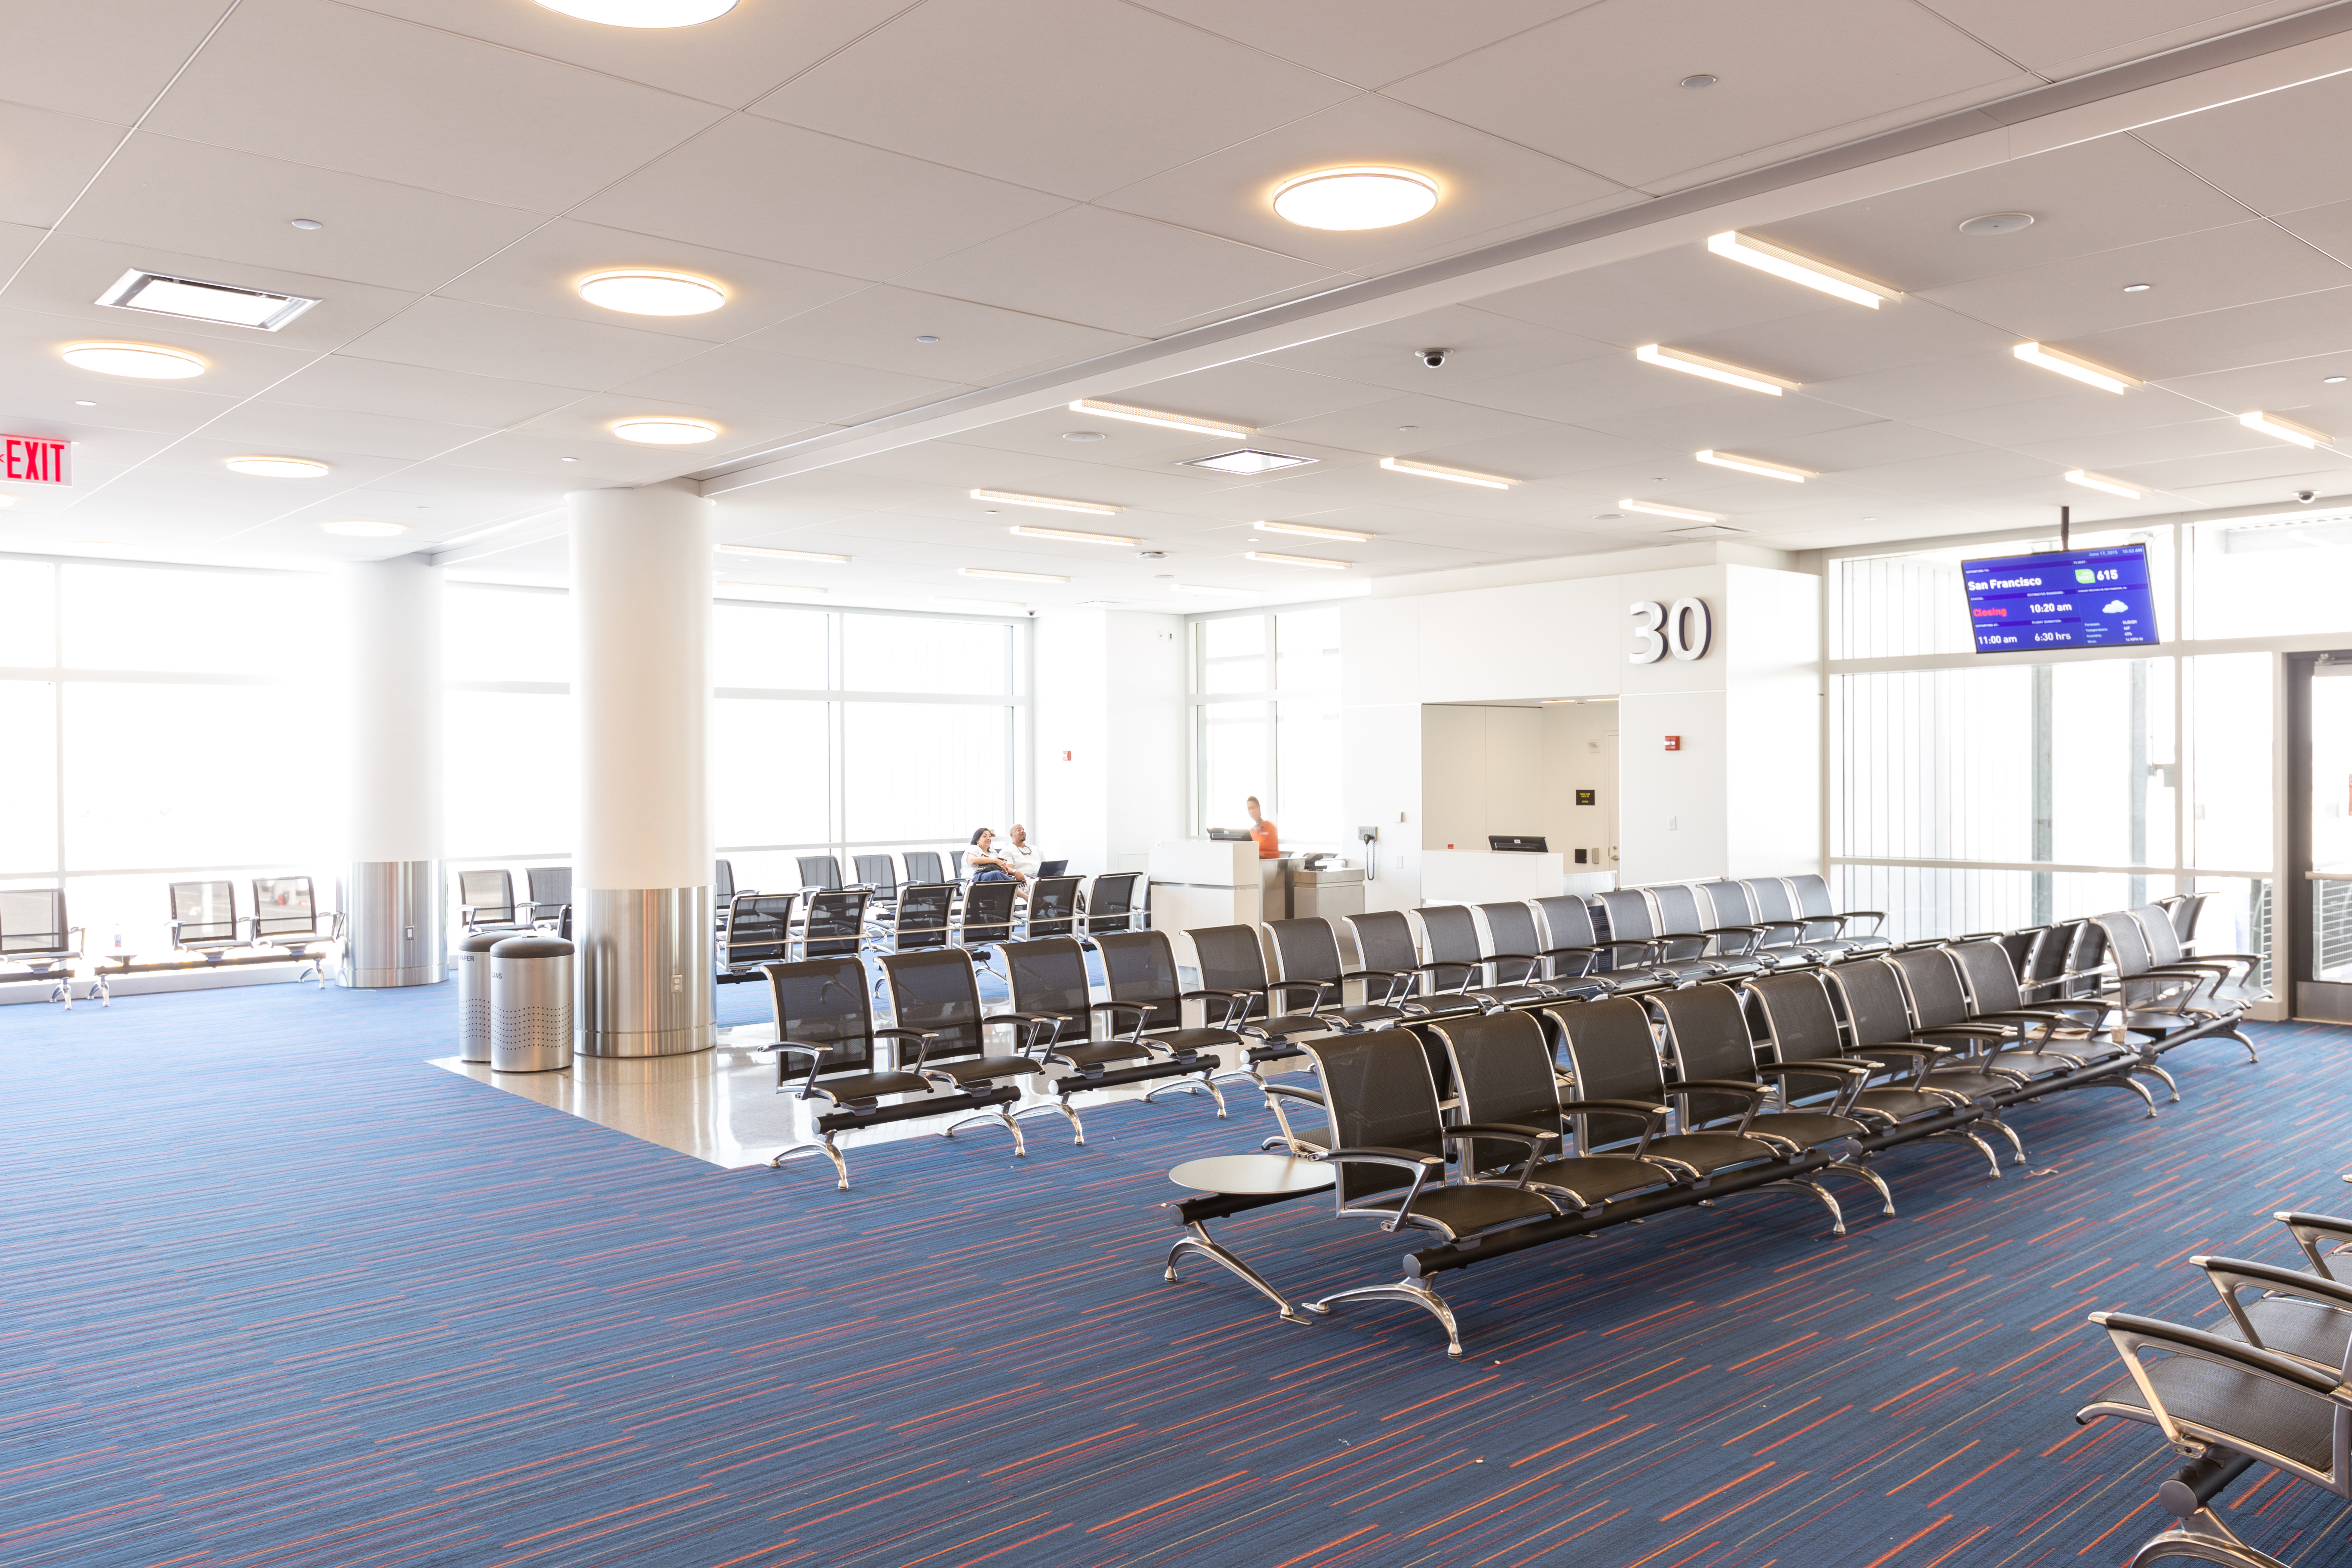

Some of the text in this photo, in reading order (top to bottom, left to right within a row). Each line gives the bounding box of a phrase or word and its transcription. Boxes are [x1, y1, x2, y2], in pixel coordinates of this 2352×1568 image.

[6, 439, 64, 482] EXIT
[2097, 569, 2118, 581] 615
[1968, 577, 2042, 591] San Francisco
[1973, 607, 2007, 617] Closing
[2030, 603, 2055, 613] 10:20
[1629, 597, 1712, 664] 30
[1978, 635, 2002, 645] 11:00
[2035, 632, 2071, 642] 6:30 hrs
